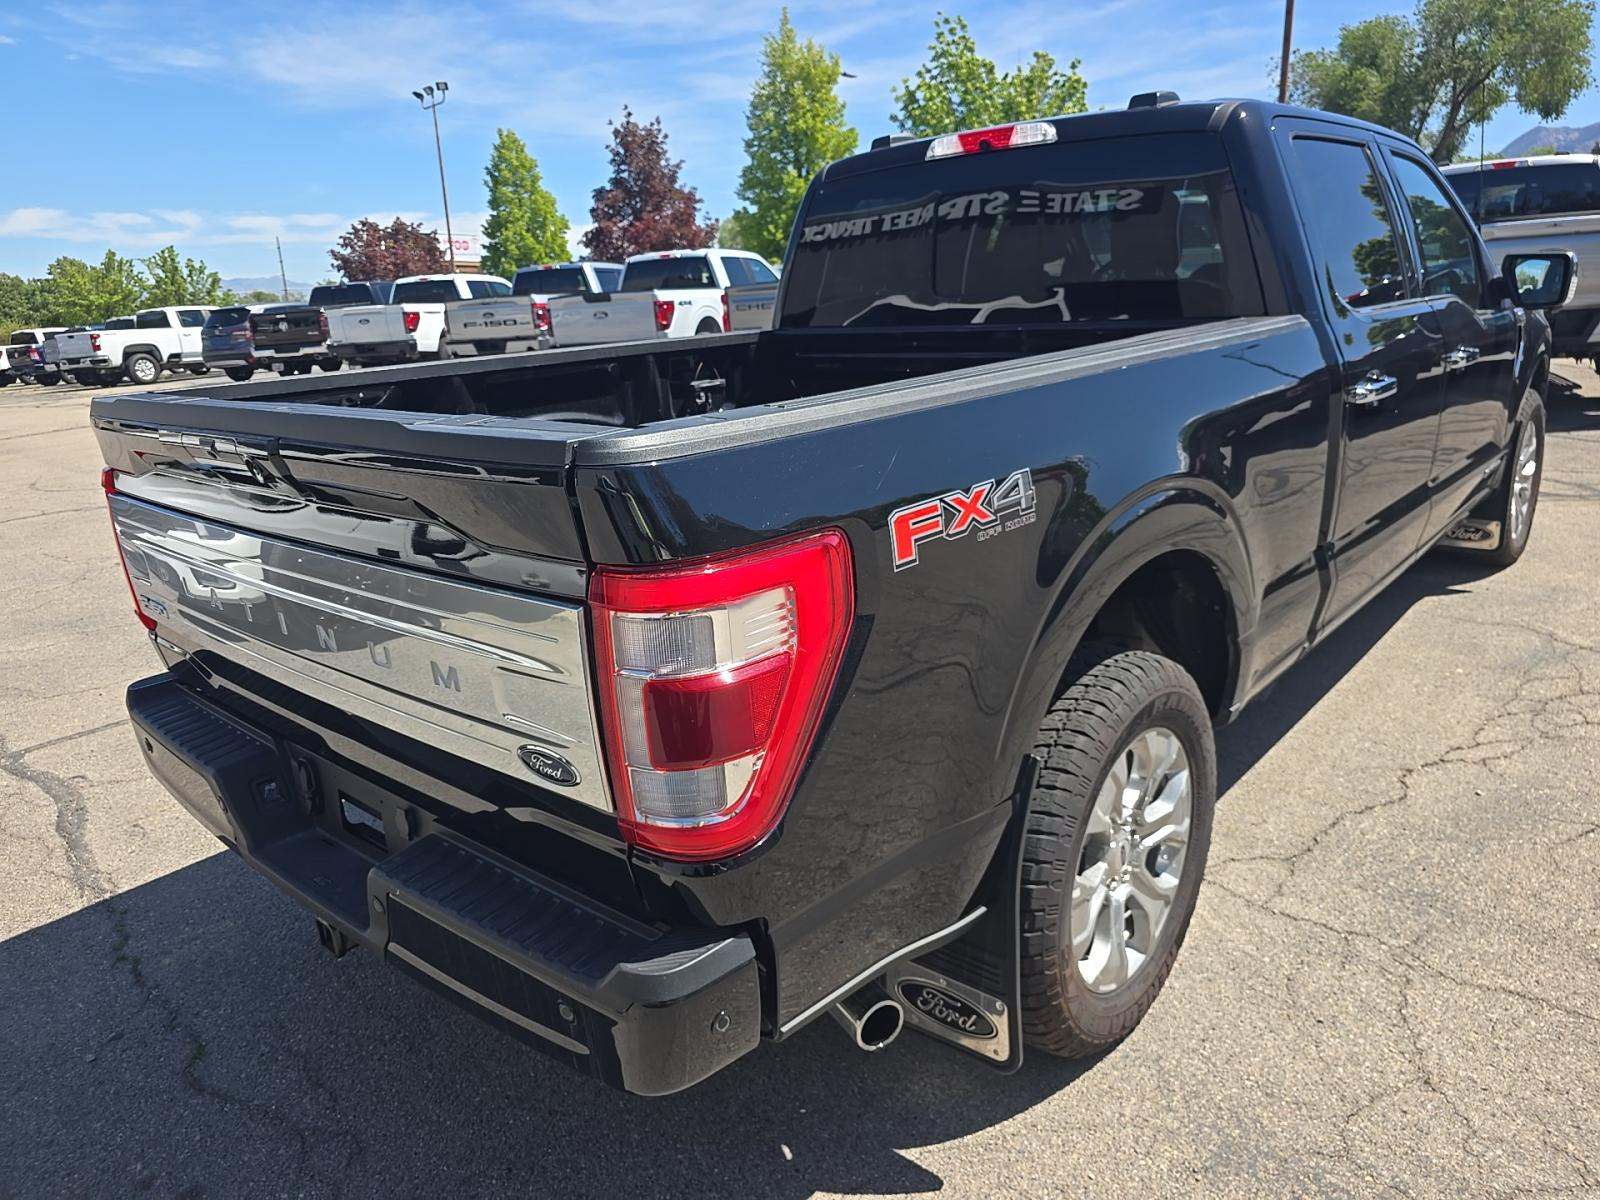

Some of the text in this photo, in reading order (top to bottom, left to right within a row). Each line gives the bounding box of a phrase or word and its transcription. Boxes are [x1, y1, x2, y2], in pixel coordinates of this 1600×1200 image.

[888, 467, 1036, 573] FX4
[530, 754, 564, 779] Ford
[917, 988, 977, 1031] Ford
